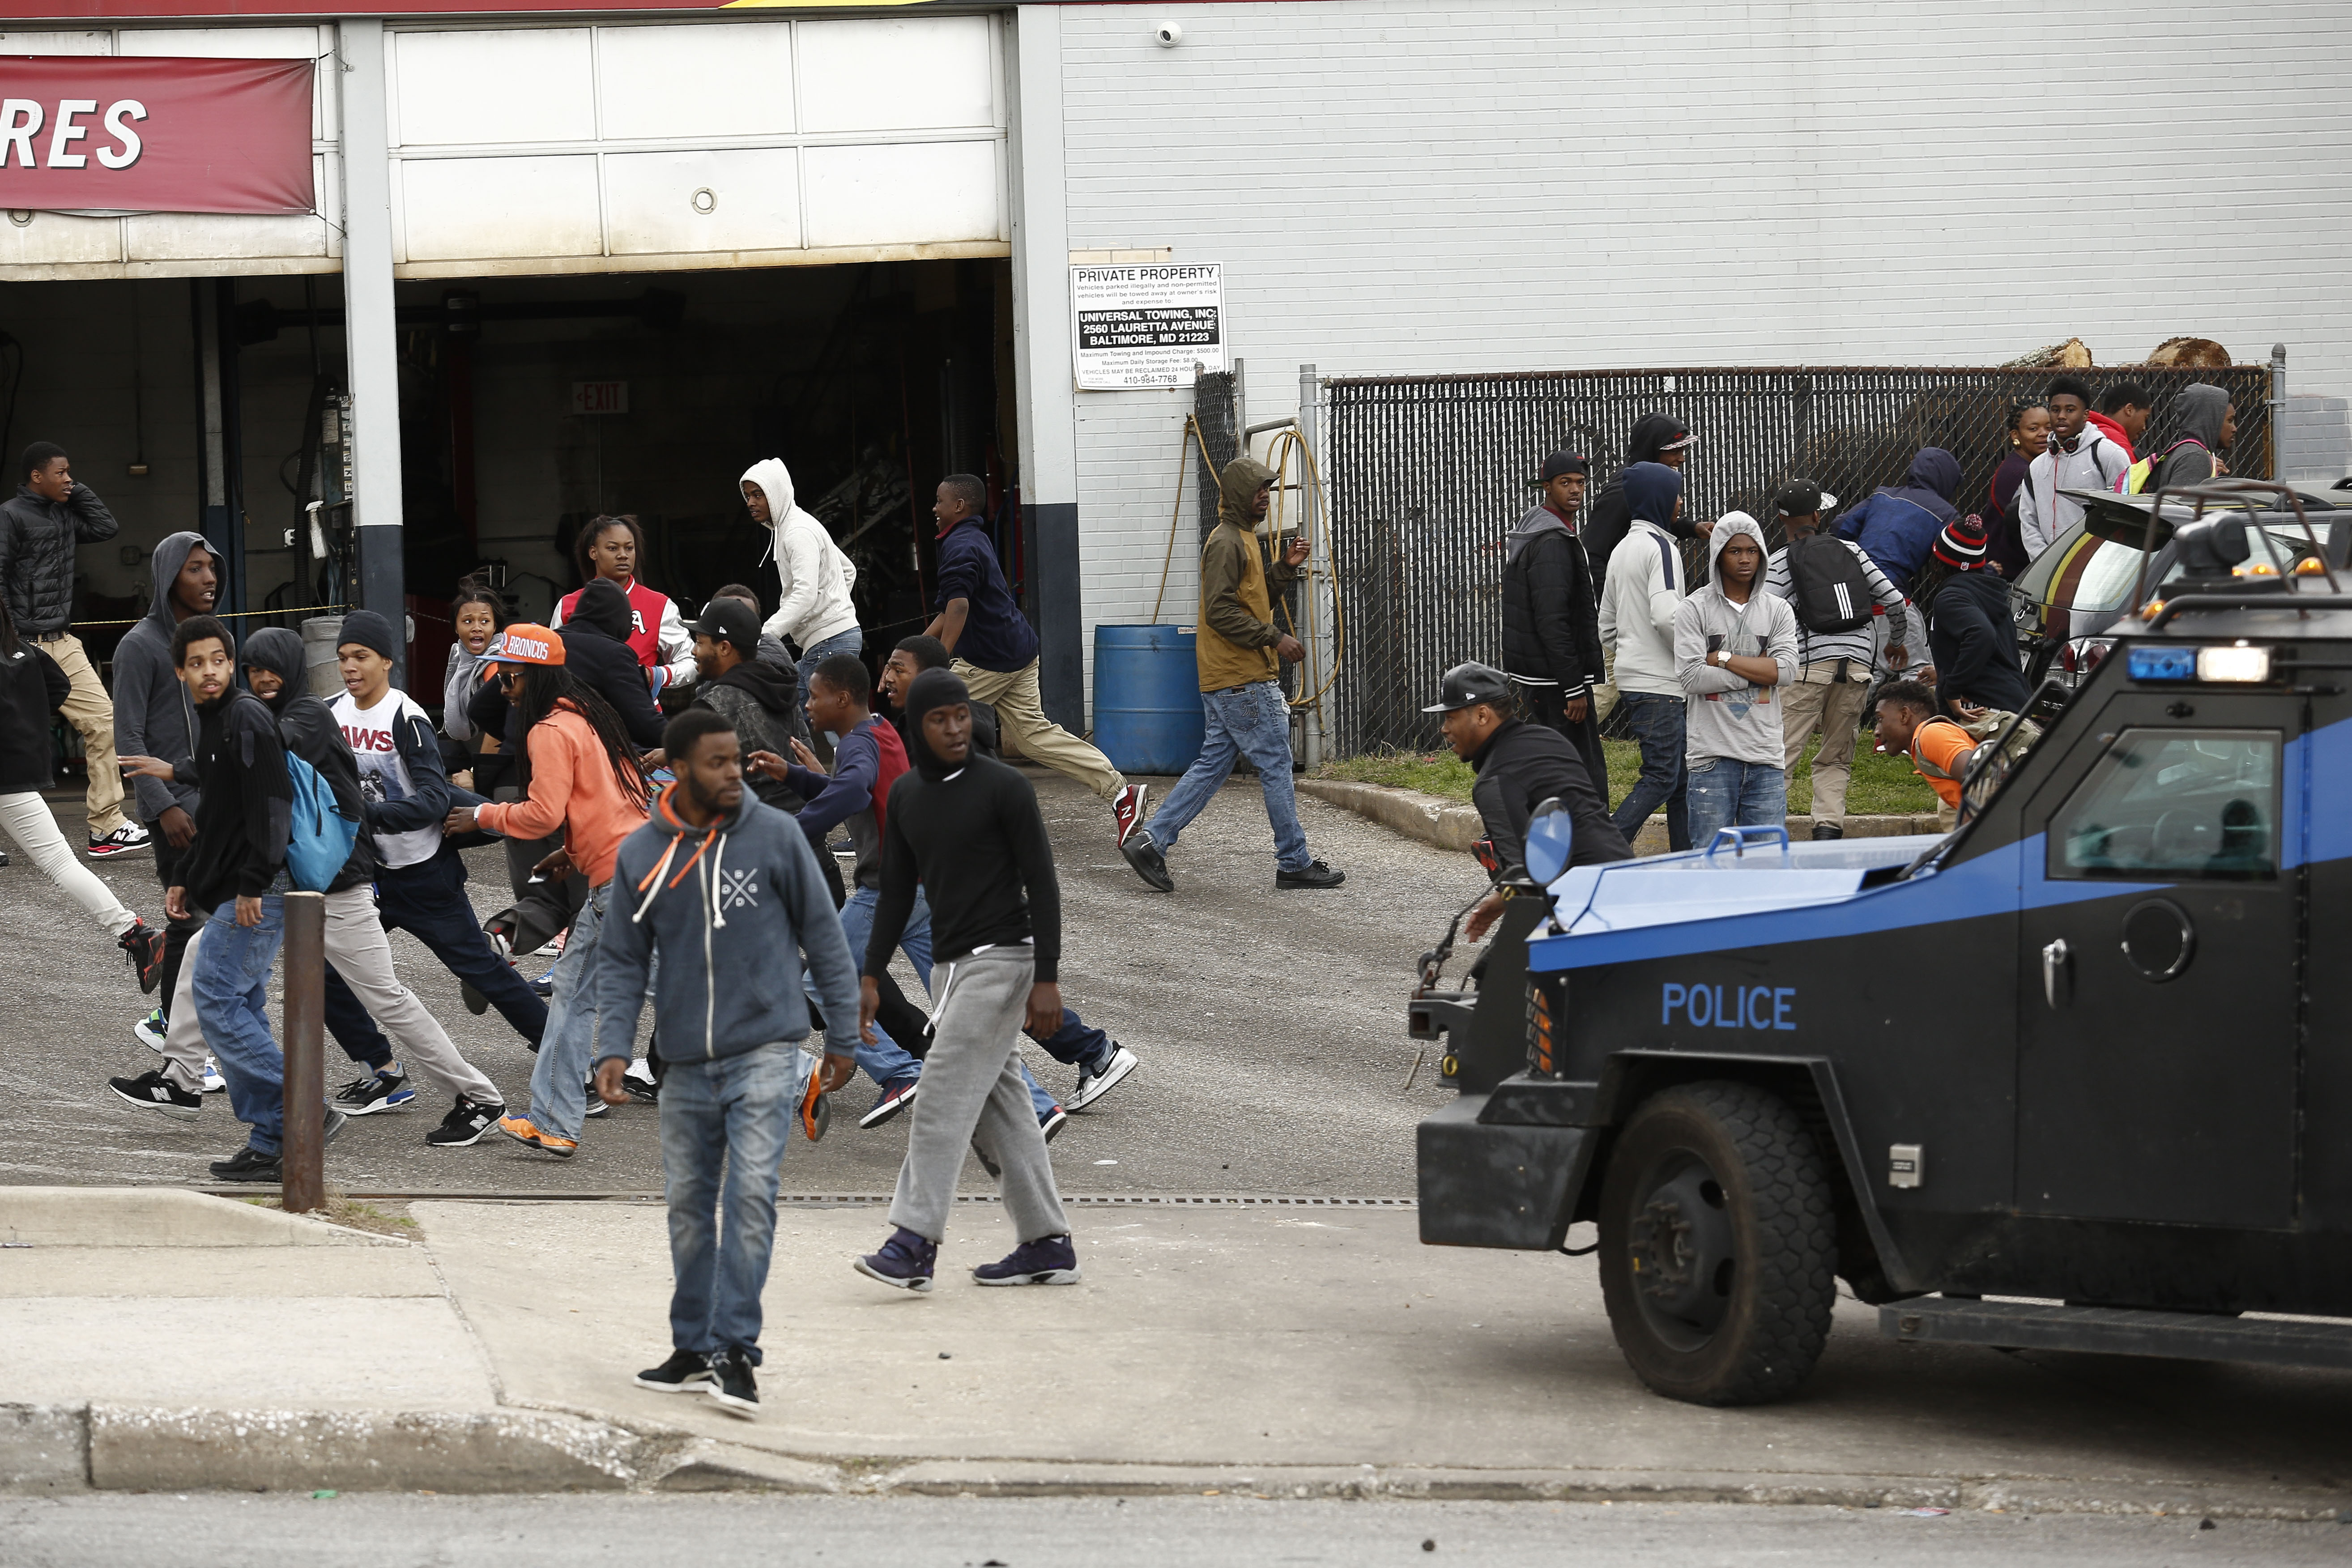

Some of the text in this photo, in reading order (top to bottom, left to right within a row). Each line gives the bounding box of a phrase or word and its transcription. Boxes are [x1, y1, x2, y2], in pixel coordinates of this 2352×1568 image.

[1079, 267, 1214, 282] PRIVATE PROPERTY
[1080, 309, 1217, 322] UNIVERSAL TOWING, INC.
[1083, 320, 1214, 334] 2560 LAURETTA AVENUE
[1090, 332, 1210, 345] BALTIMORE, MD 21223
[1124, 375, 1177, 384] 410-984-7768
[584, 383, 620, 411] EXIT
[507, 635, 550, 660] BRONCOS
[112, 831, 127, 841] N
[1662, 982, 1797, 1030] POLICE
[150, 1087, 172, 1101] N
[469, 1114, 490, 1131] N
